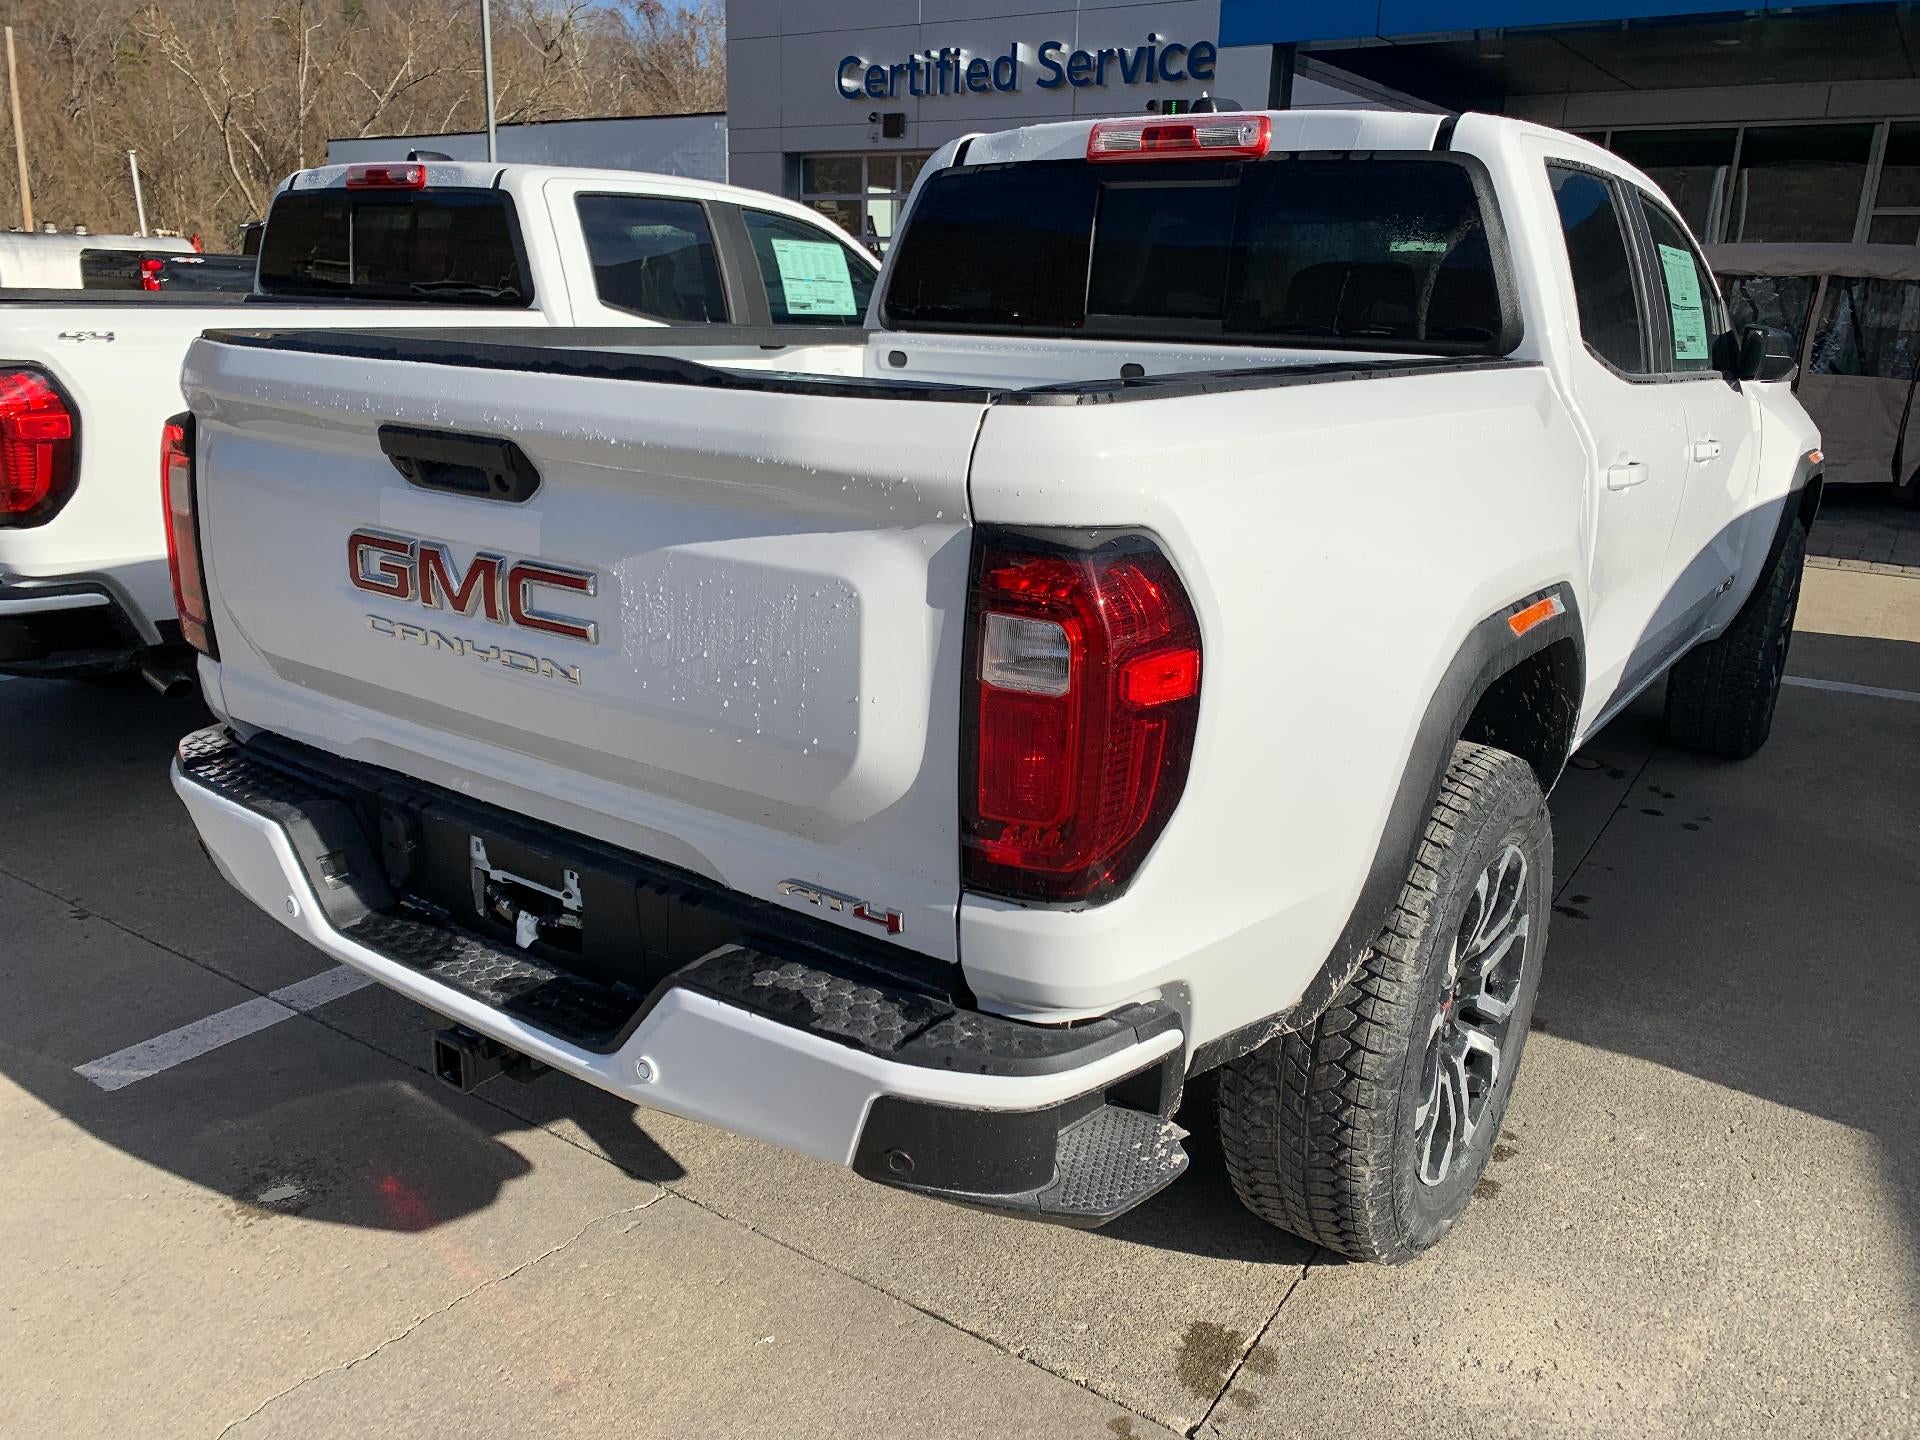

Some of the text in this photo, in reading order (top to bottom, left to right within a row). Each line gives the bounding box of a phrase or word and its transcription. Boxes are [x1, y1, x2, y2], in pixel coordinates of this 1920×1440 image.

[836, 33, 1217, 100] Certified Service
[348, 528, 599, 645] GMC
[364, 614, 581, 686] CANYON
[776, 878, 905, 935] AT4
